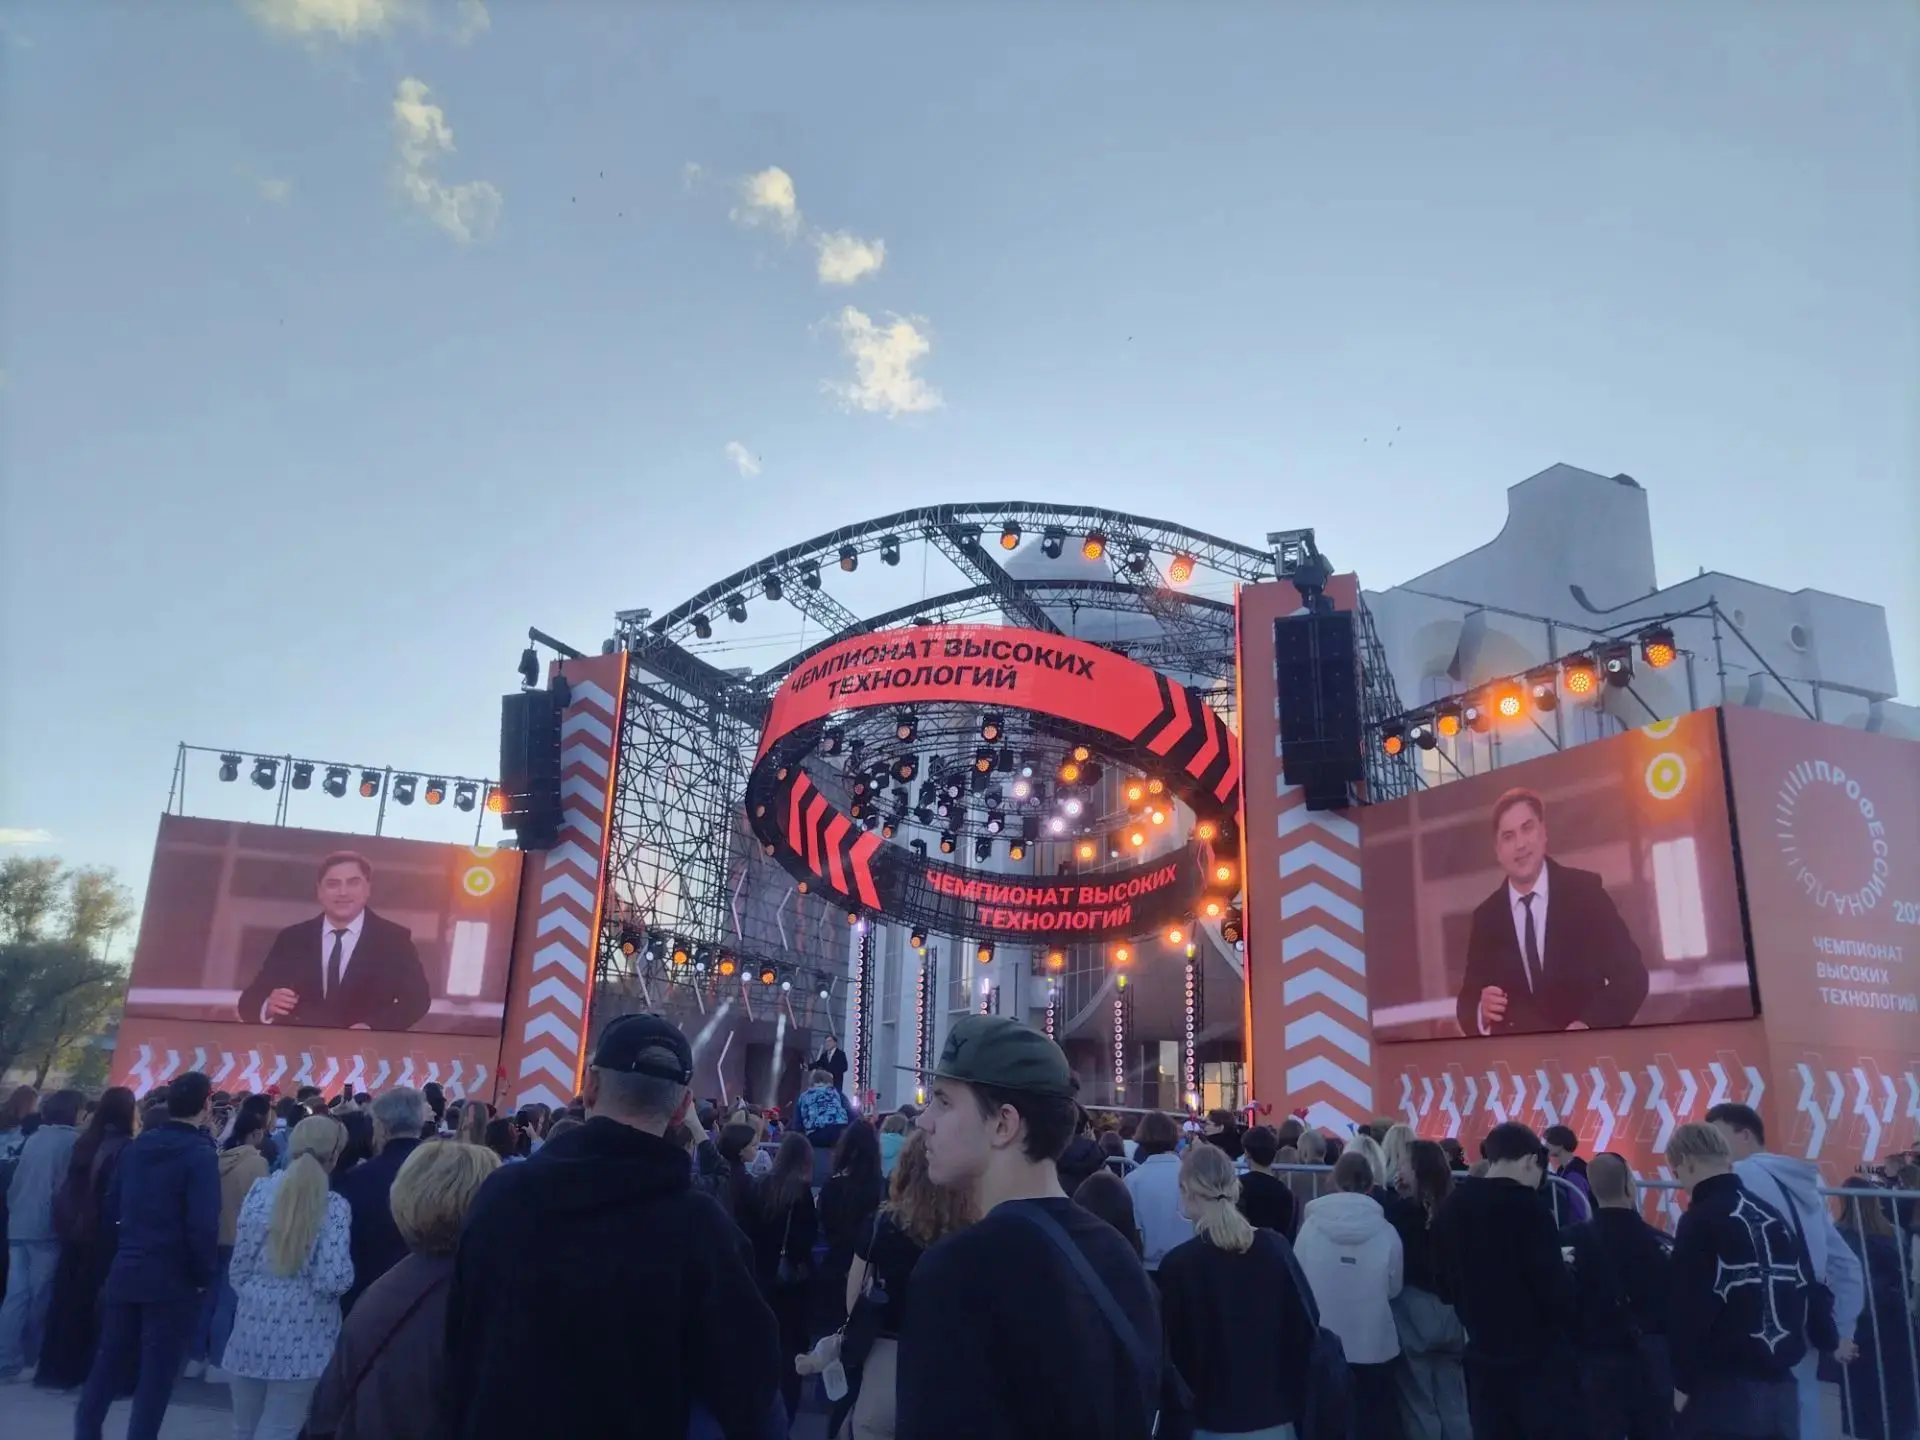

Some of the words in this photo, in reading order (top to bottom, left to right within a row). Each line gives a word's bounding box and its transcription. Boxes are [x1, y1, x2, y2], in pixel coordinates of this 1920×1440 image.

[790, 639, 938, 693] ЧЕМПИОНАТ
[943, 638, 1096, 680] ВЫСОКИХ
[828, 664, 1018, 700] ТЕХНОЛОГИЙ
[1796, 759, 1888, 916] ПРОФЕССИОНАЛЫ
[925, 868, 1074, 906] ЧЕМПИОНАТ
[1077, 863, 1177, 905] ВЫСОКИХ
[977, 903, 1132, 930] ТЕХНОЛОГИЙ
[1812, 936, 1903, 962] ЧЕМПИОНАТ
[1816, 960, 1889, 985] ВЫСОКИХ
[1818, 986, 1919, 1013] ТЕХНОЛОГИЙ
